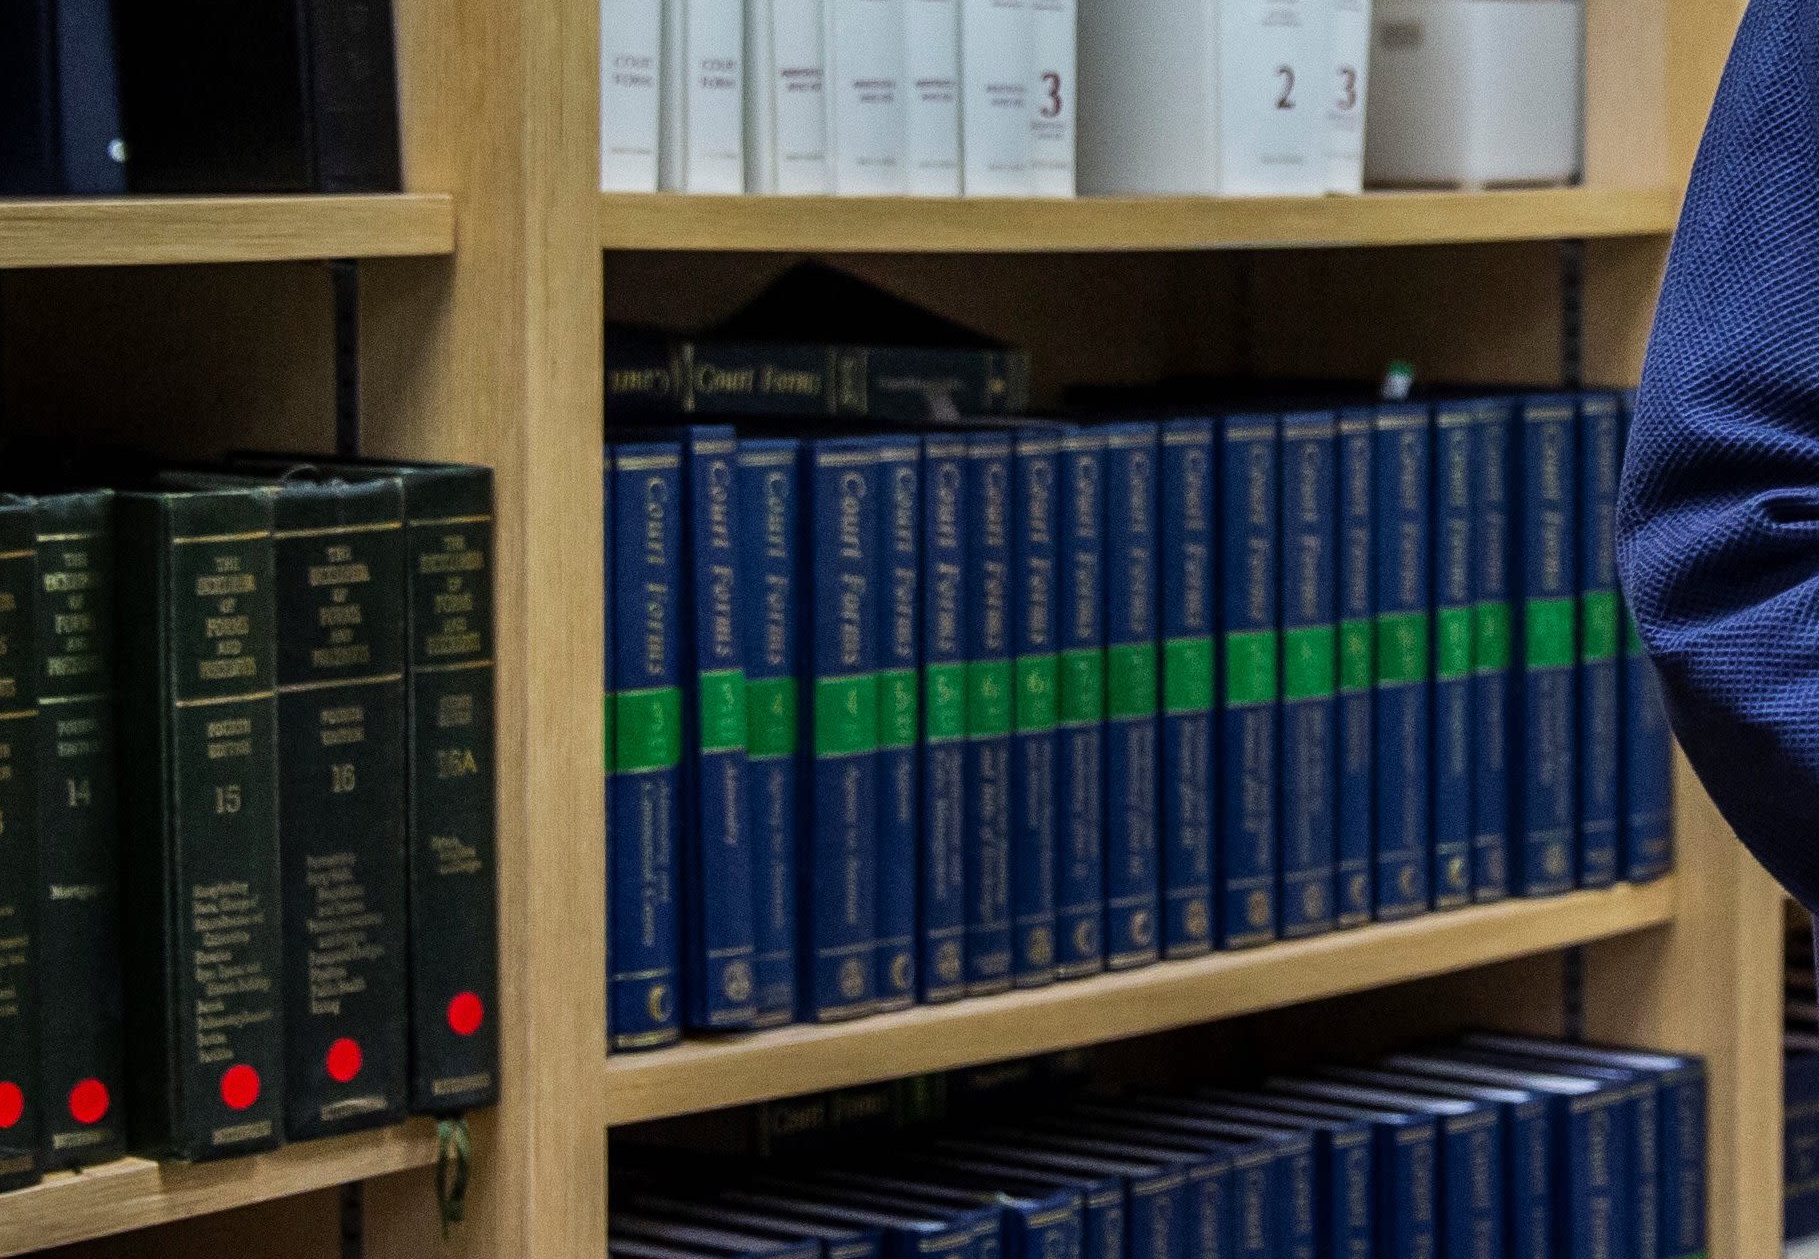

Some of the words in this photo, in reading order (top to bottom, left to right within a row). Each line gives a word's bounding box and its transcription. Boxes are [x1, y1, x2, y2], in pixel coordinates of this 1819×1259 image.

[1040, 70, 1064, 119] 3
[1272, 63, 1297, 112] 2
[1335, 64, 1358, 111] 3
[214, 783, 242, 815] 15
[330, 763, 357, 794] 16
